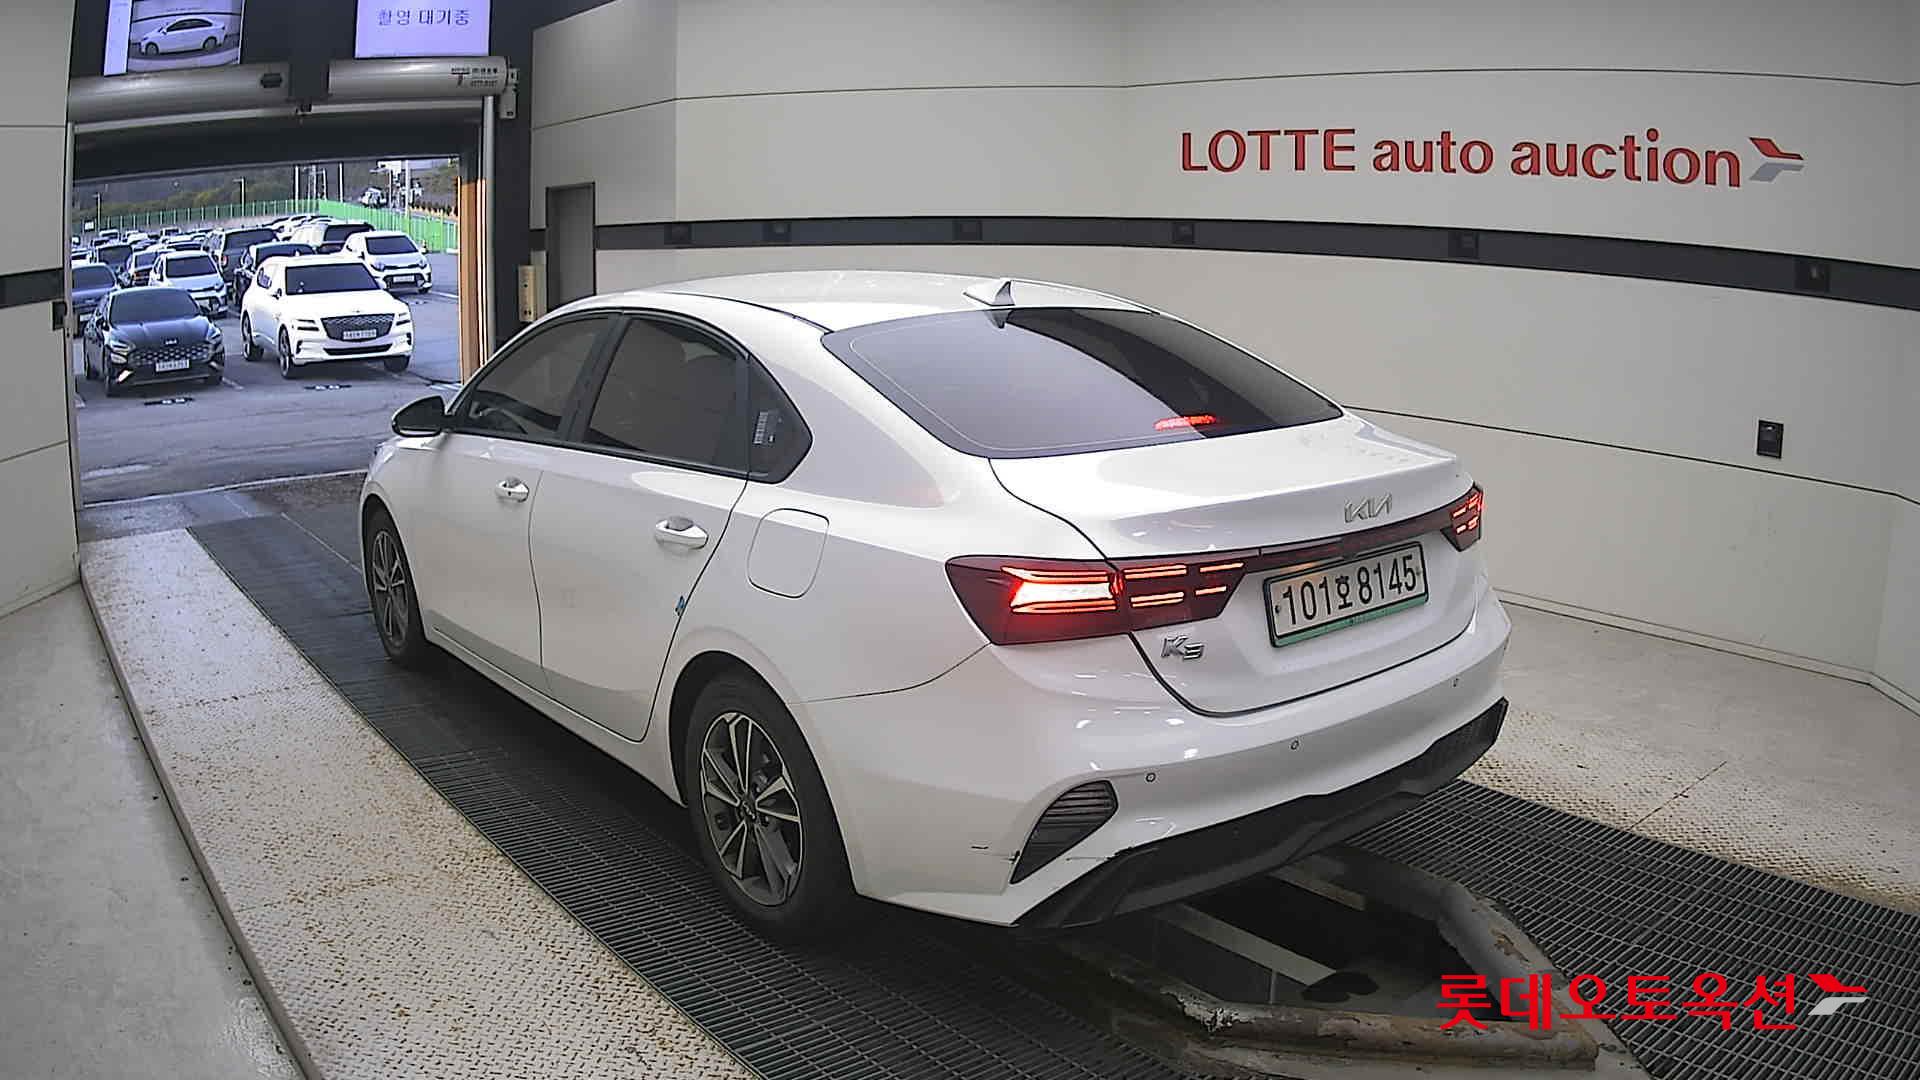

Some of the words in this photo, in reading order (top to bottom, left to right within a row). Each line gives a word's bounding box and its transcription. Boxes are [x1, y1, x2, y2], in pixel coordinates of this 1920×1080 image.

[419, 8, 470, 27] 대기중
[1180, 128, 1356, 172] LOTTE
[1372, 130, 1495, 174] auto
[1510, 128, 1742, 188] auction
[1344, 492, 1392, 523] KIA
[1161, 634, 1205, 660] K3
